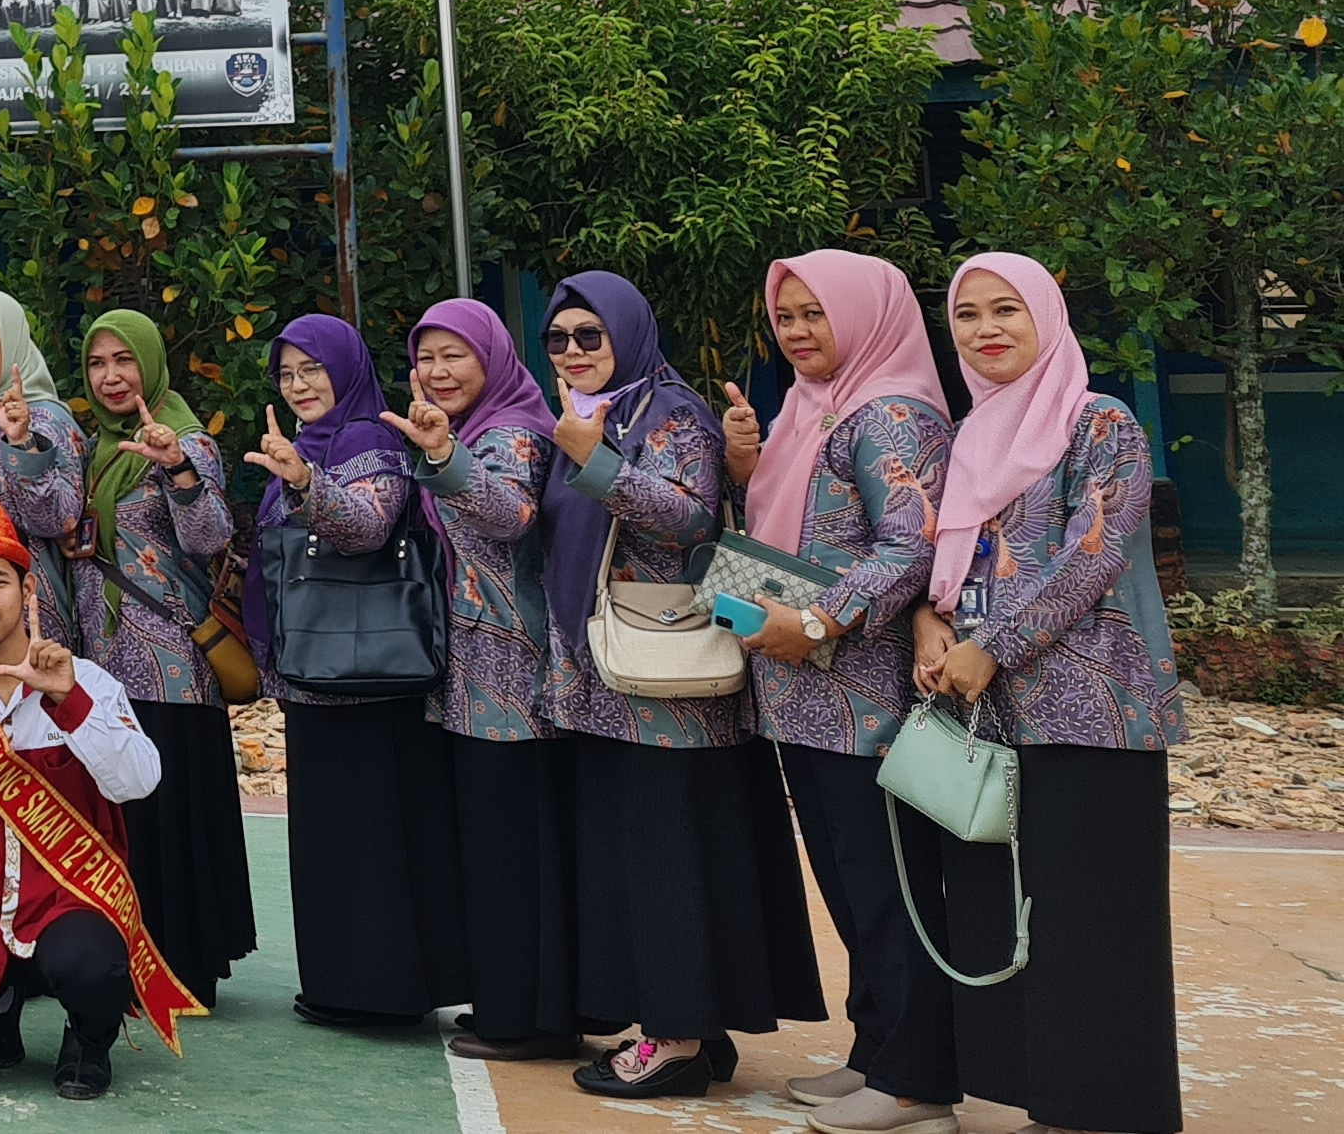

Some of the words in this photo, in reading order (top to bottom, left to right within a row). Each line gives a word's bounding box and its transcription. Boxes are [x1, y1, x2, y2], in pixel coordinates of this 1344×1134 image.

[99, 62, 118, 76] 12
[16, 789, 76, 852] SMAN
[58, 833, 93, 870] 12
[131, 939, 157, 994] 2022
